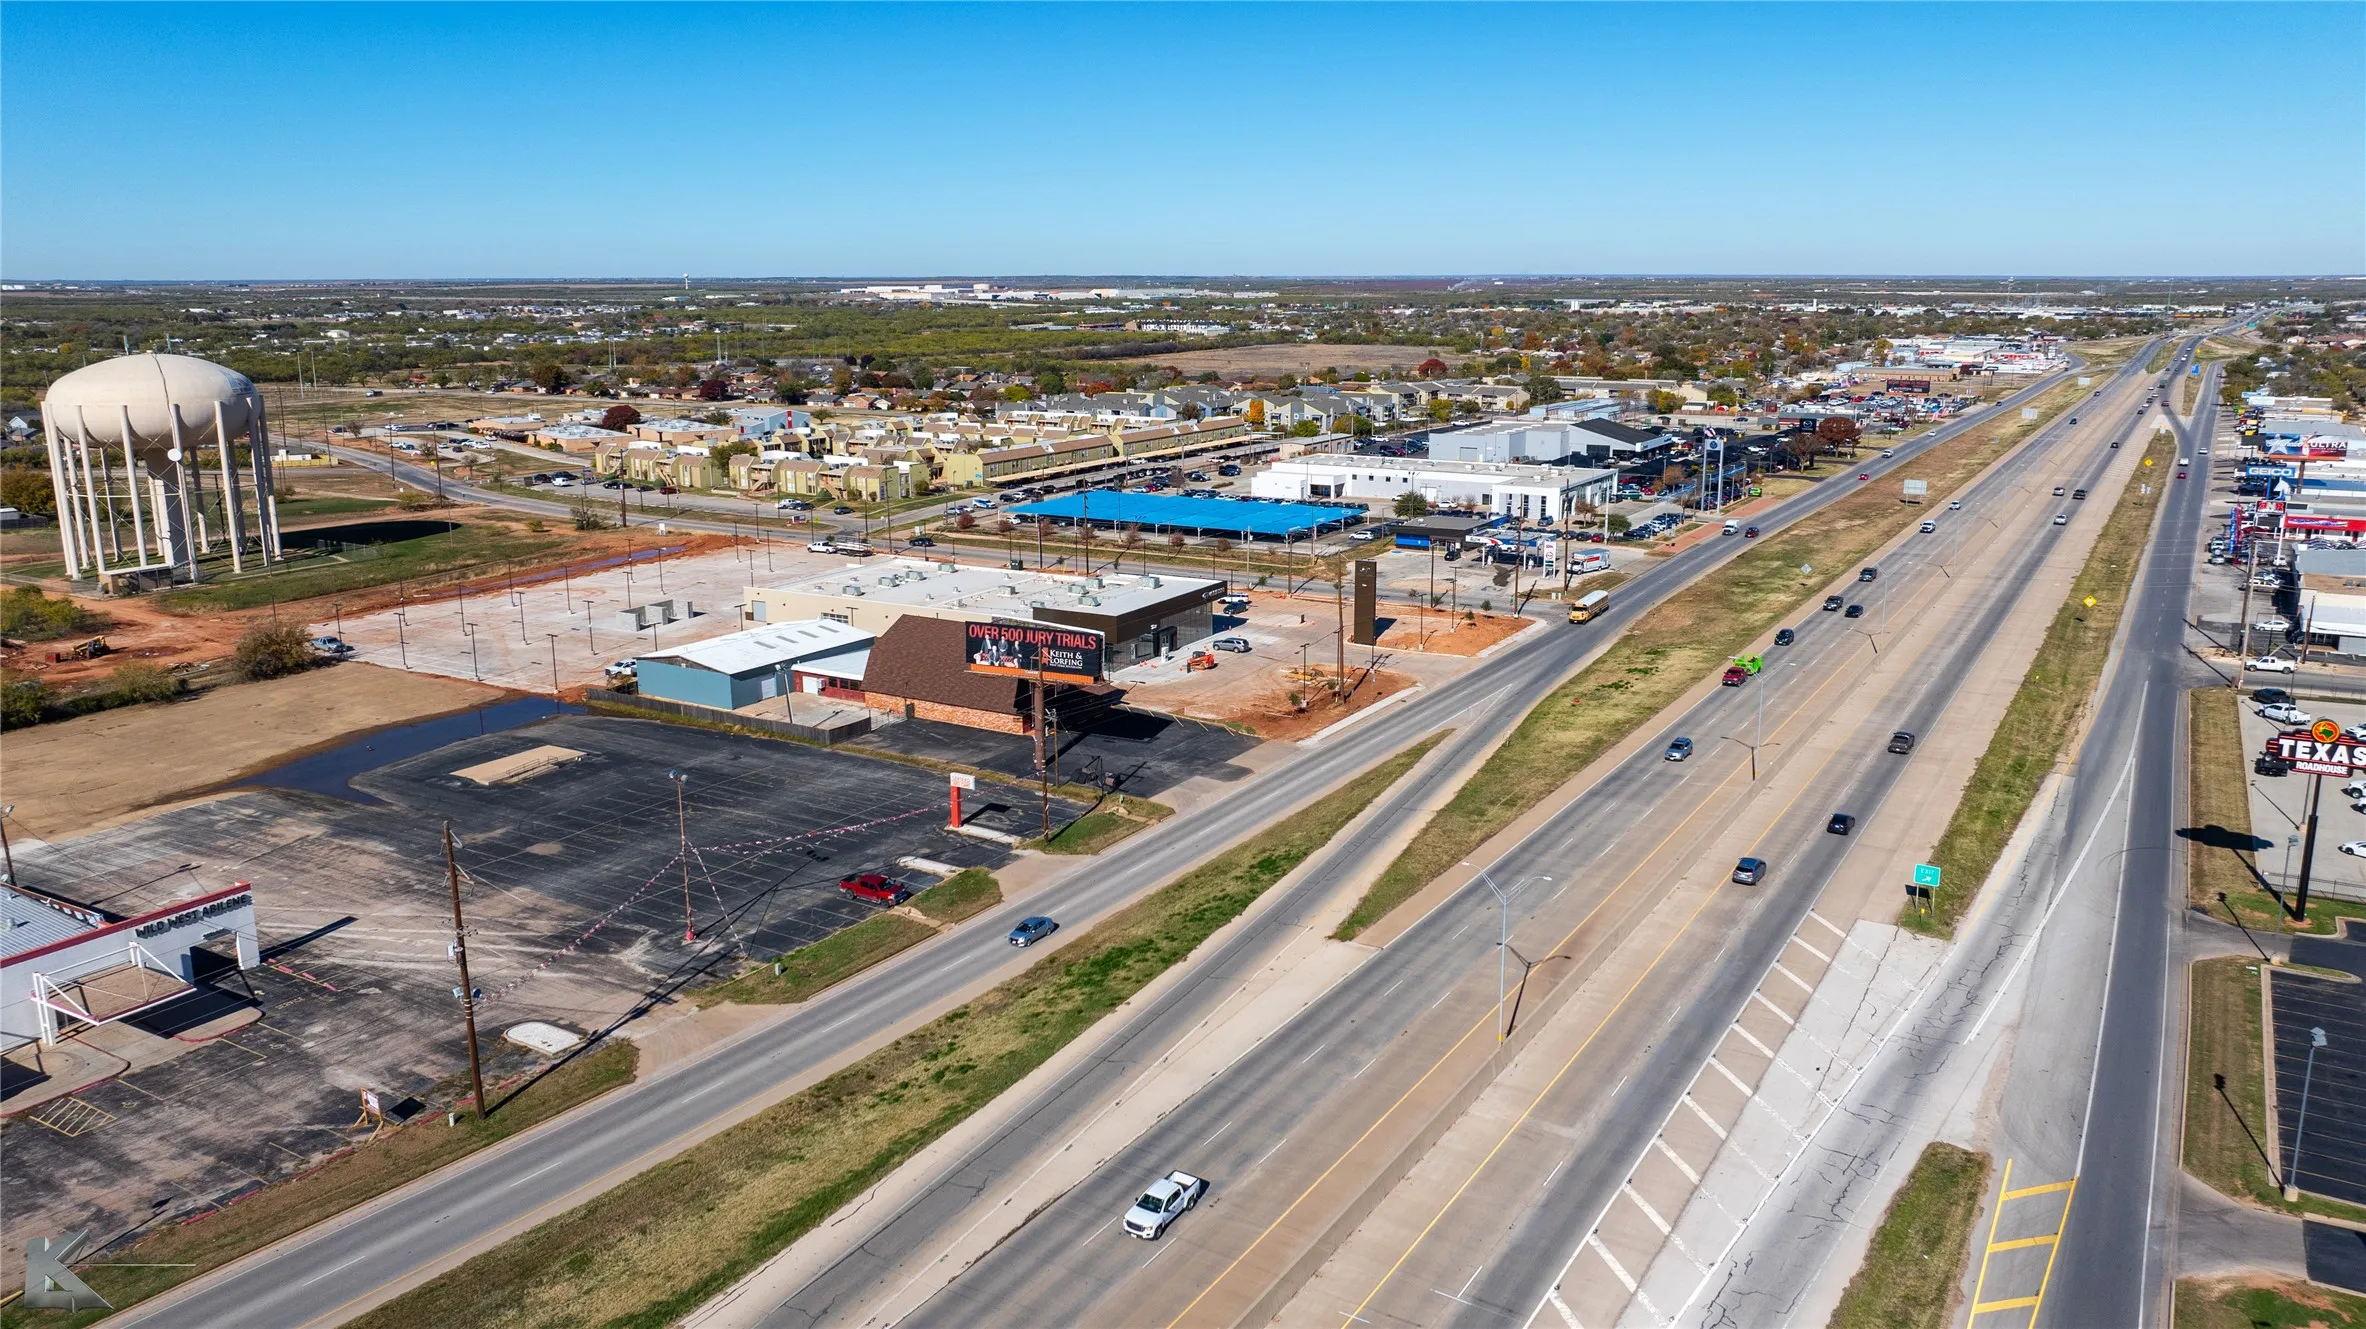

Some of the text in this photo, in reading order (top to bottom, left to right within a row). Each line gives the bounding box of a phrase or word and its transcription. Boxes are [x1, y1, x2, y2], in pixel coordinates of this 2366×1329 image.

[2248, 467, 2293, 476] GEICO
[968, 624, 1097, 650] OVER 500 JURY TRIALS
[1050, 649, 1083, 660] KEITH &
[1050, 657, 1083, 667] LORFING
[2278, 738, 2366, 766] TEXAS
[2295, 761, 2348, 775] ROADHOUSE
[135, 895, 247, 938] WILD WEST ABILENE
